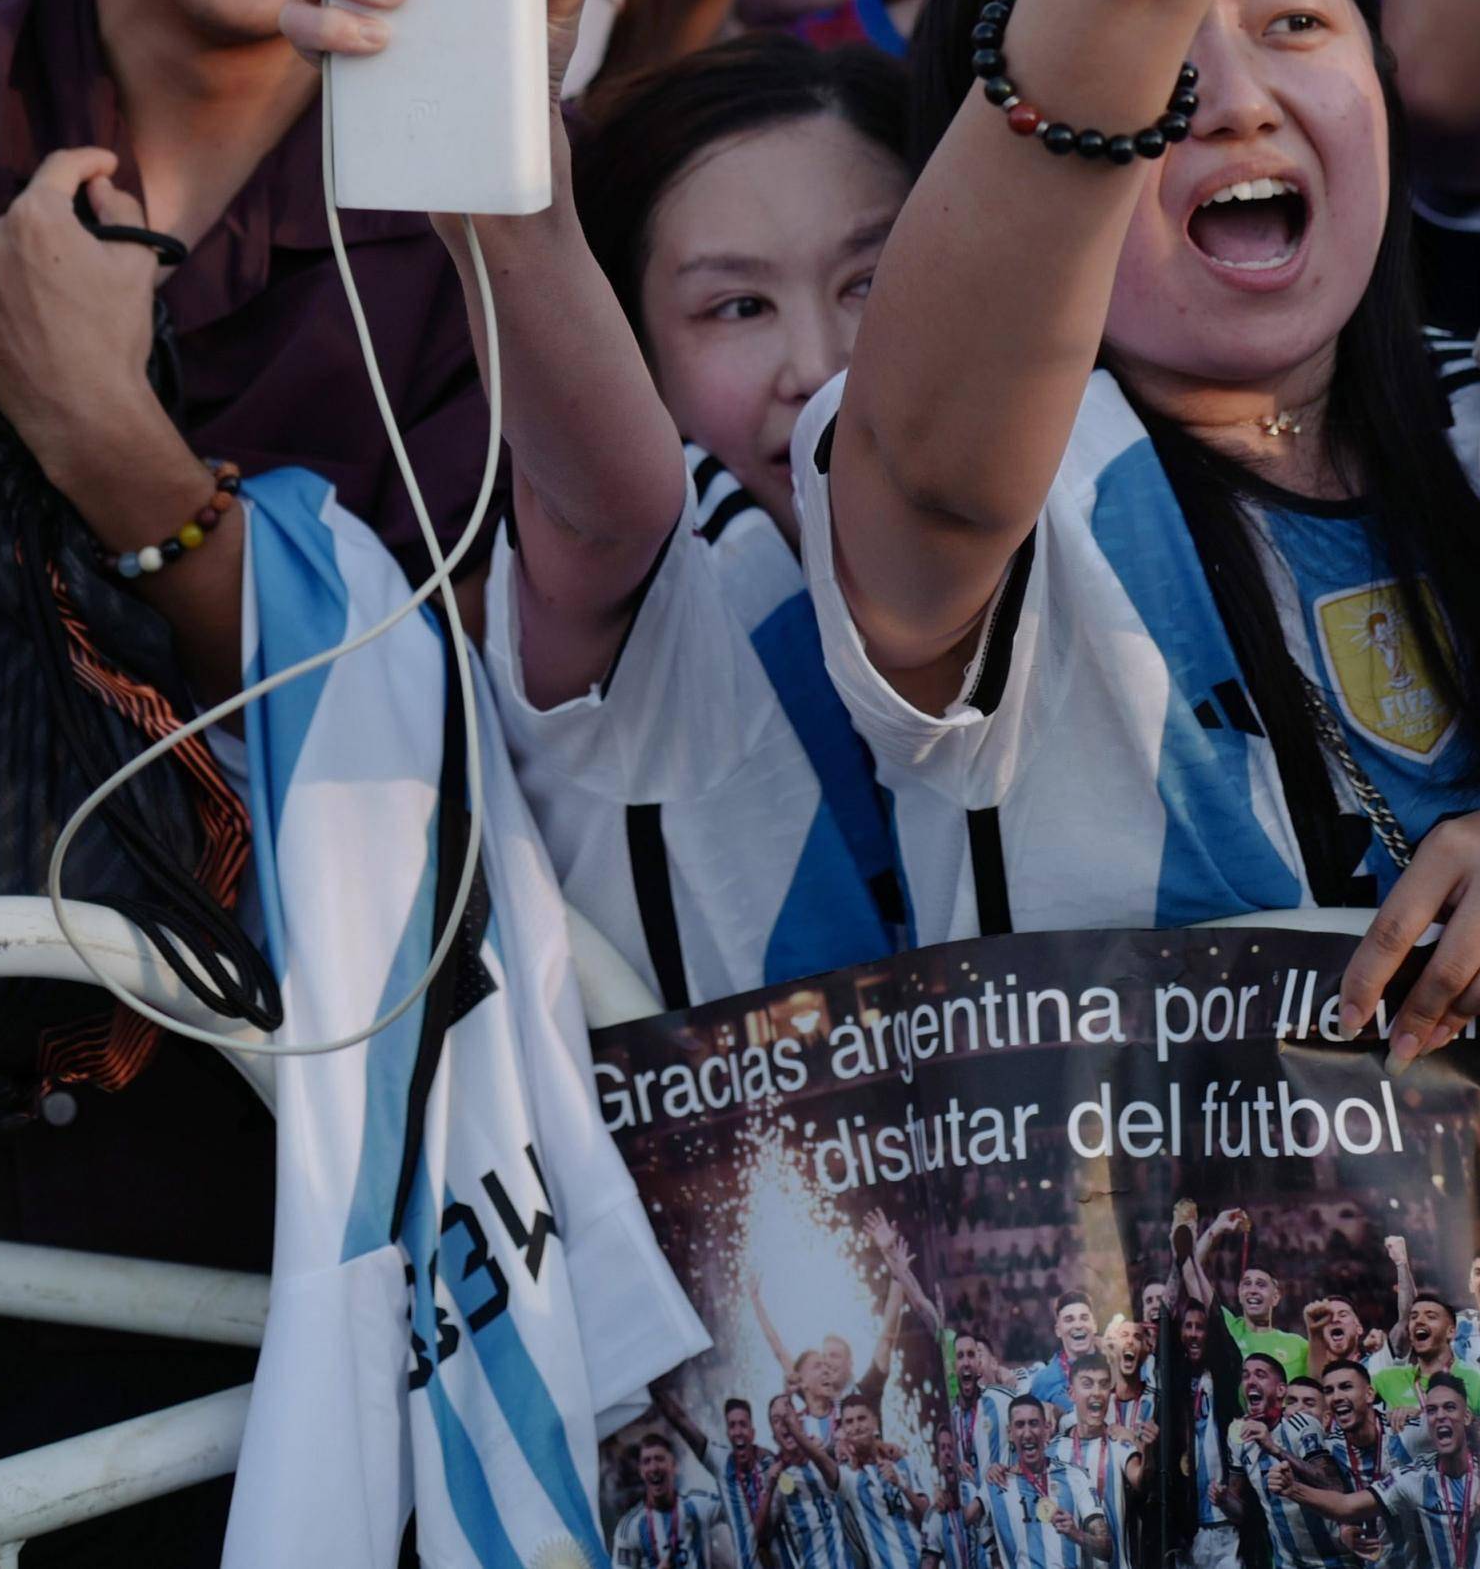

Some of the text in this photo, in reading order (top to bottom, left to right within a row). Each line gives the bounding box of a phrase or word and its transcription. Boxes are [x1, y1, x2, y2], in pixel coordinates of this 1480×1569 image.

[593, 1032, 808, 1134] Gracias
[830, 973, 1126, 1085] argentina
[1154, 983, 1260, 1063] por
[1067, 1081, 1183, 1159] del
[1201, 1079, 1404, 1159] fútbol
